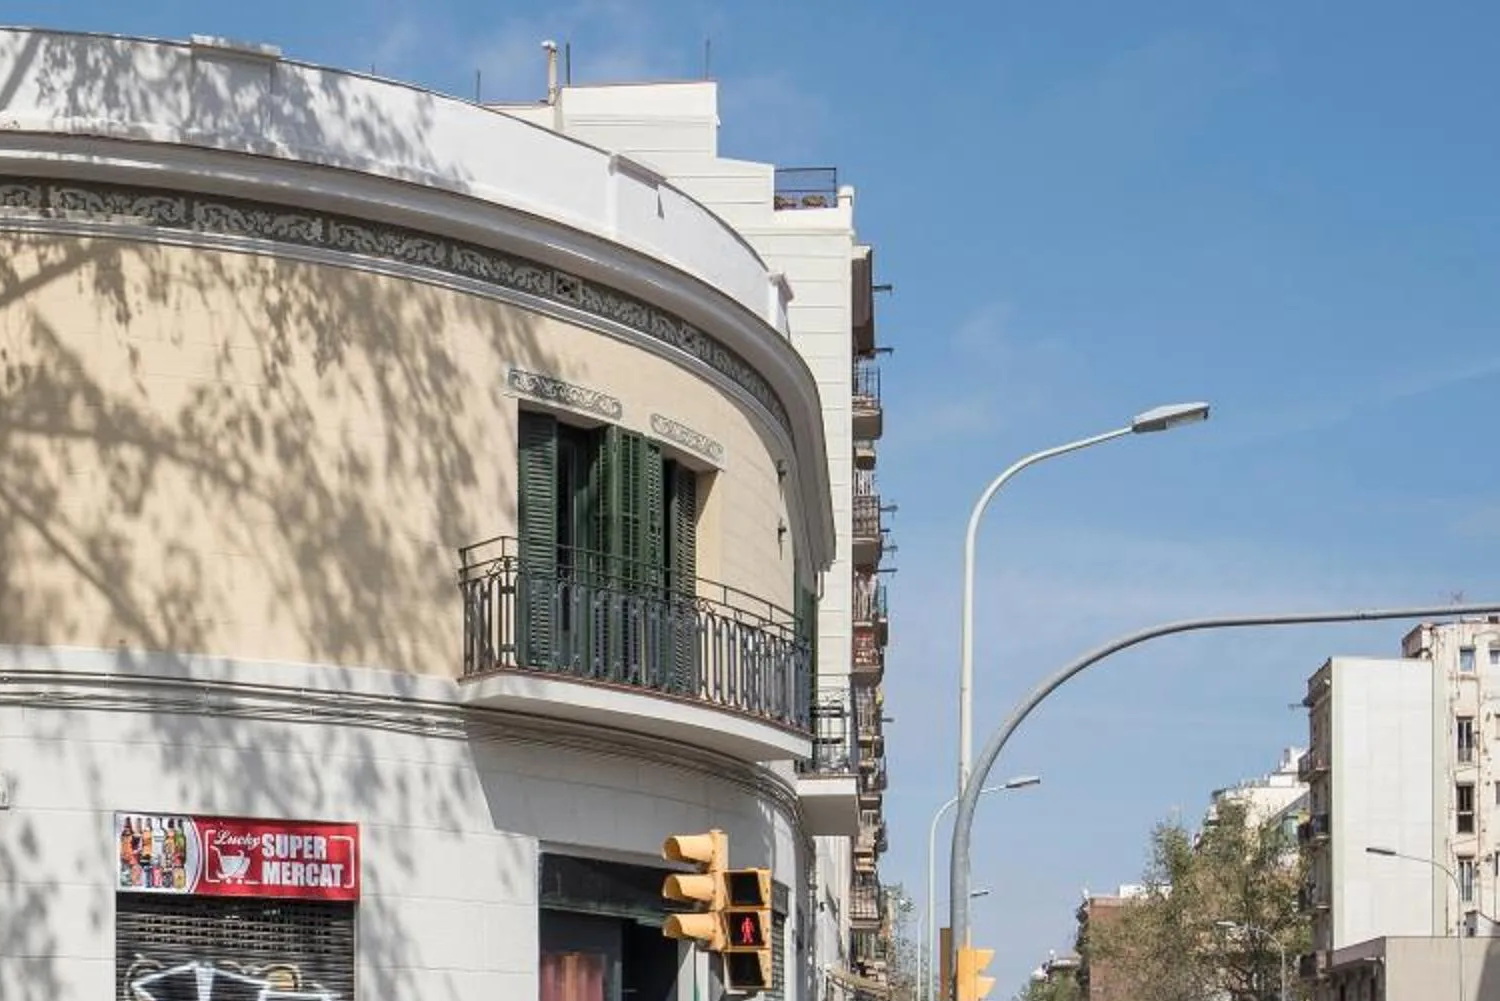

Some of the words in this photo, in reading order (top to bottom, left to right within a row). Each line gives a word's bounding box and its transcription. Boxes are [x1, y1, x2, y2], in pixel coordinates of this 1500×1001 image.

[213, 830, 260, 850] Lucky
[261, 833, 326, 859] SUPER
[262, 861, 344, 888] MERCAT
